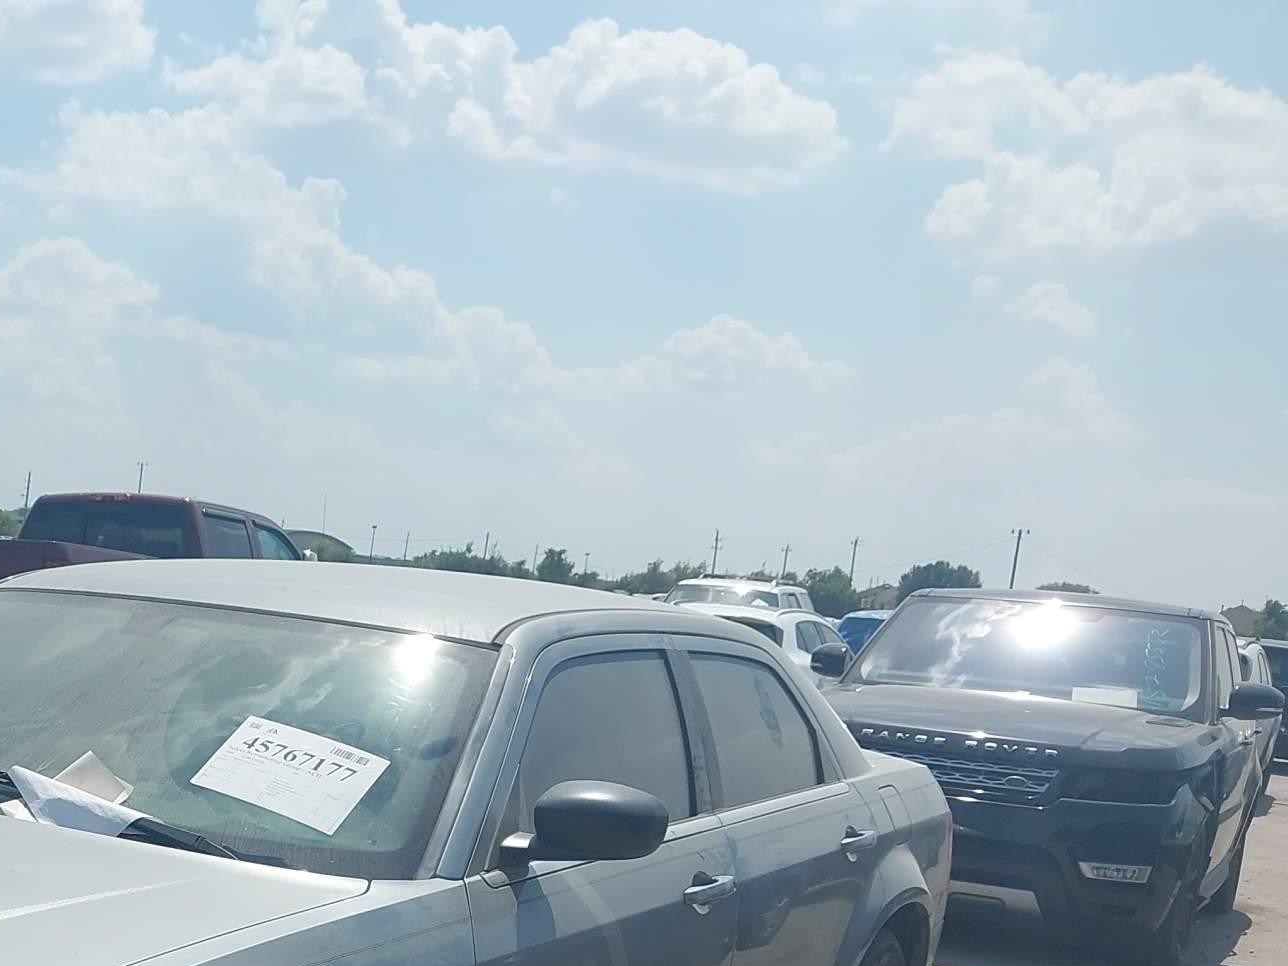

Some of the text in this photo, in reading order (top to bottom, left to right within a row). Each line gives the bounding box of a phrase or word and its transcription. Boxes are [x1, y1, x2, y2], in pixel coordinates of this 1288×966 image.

[242, 735, 359, 783] 45767177
[862, 728, 1059, 757] RANGE ROVER
